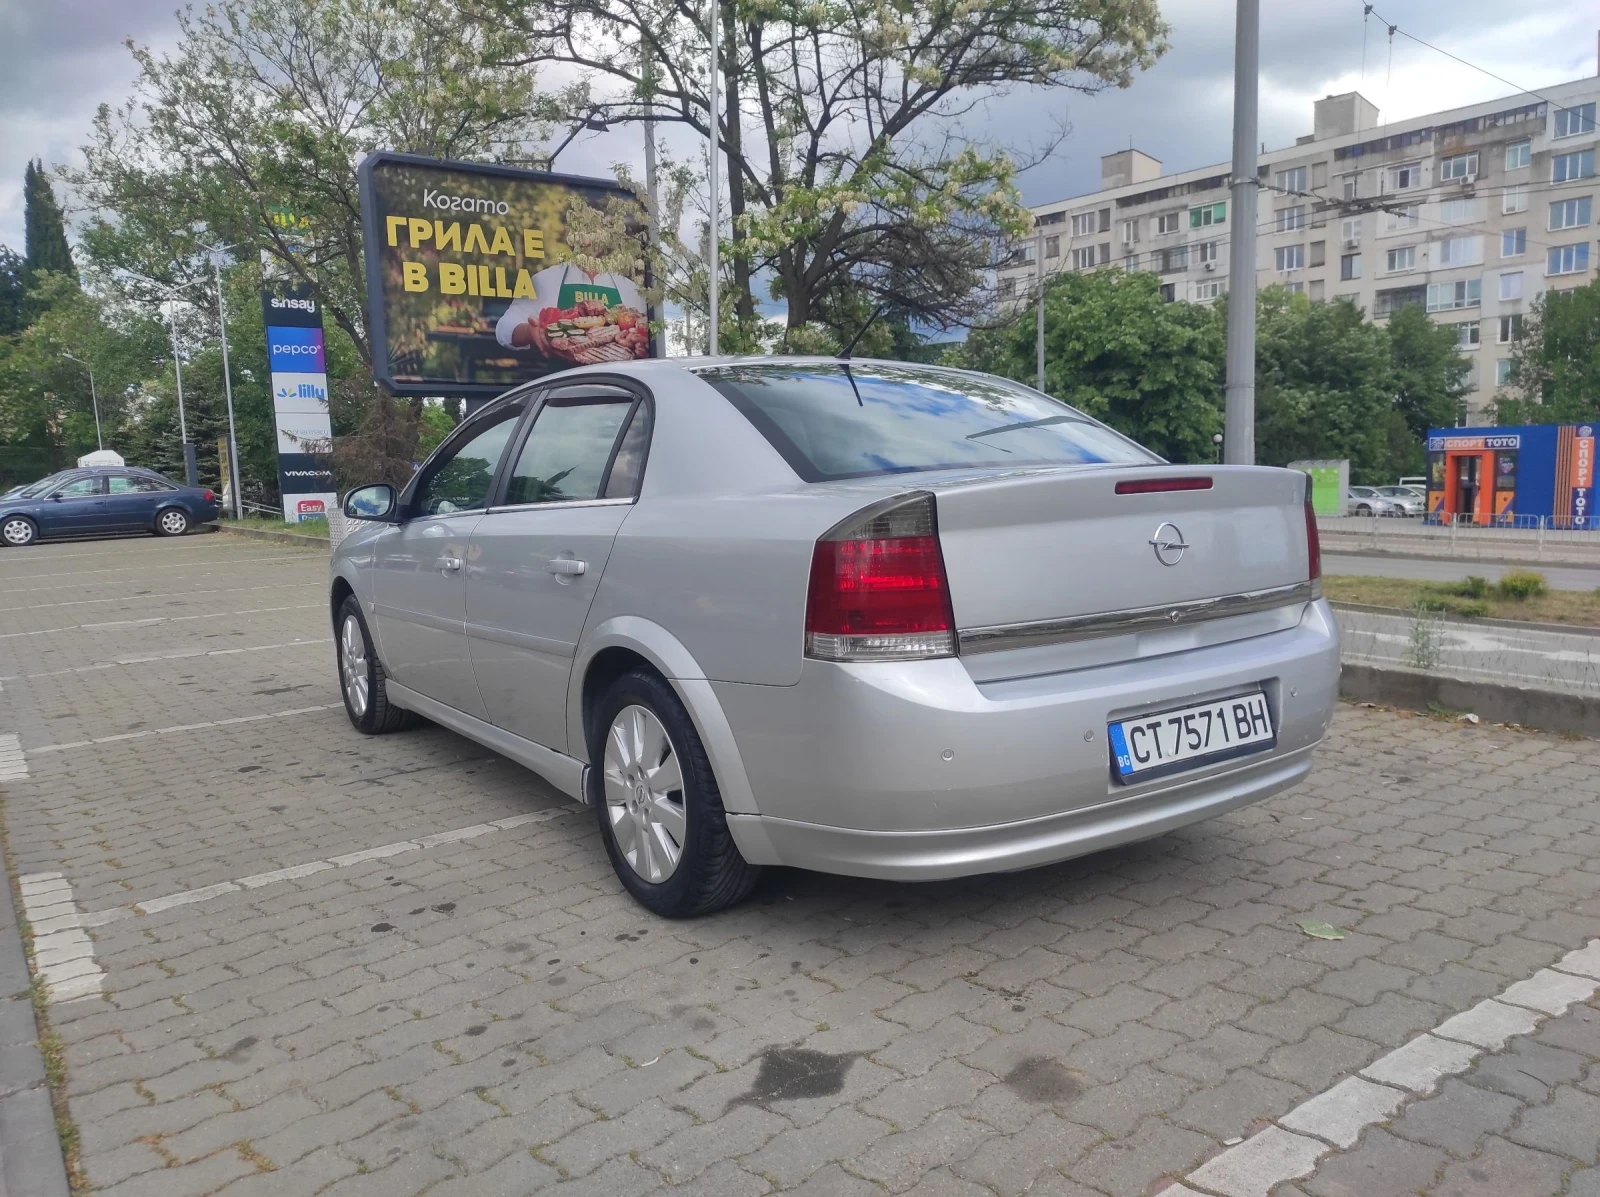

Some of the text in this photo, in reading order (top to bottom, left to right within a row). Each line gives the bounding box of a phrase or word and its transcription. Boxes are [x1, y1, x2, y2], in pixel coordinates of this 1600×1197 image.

[423, 189, 509, 216] Когато
[386, 216, 545, 259] ГРИЛА Е
[402, 262, 537, 299] В BILLA
[298, 384, 325, 399] lilly
[1446, 438, 1517, 448] СПОРТ ТОТО
[1578, 439, 1588, 486] СПОРТ
[300, 503, 322, 513] Easy
[1575, 488, 1586, 524] ТОТО
[1117, 755, 1131, 767] BG
[1168, 707, 1229, 755] 7571
